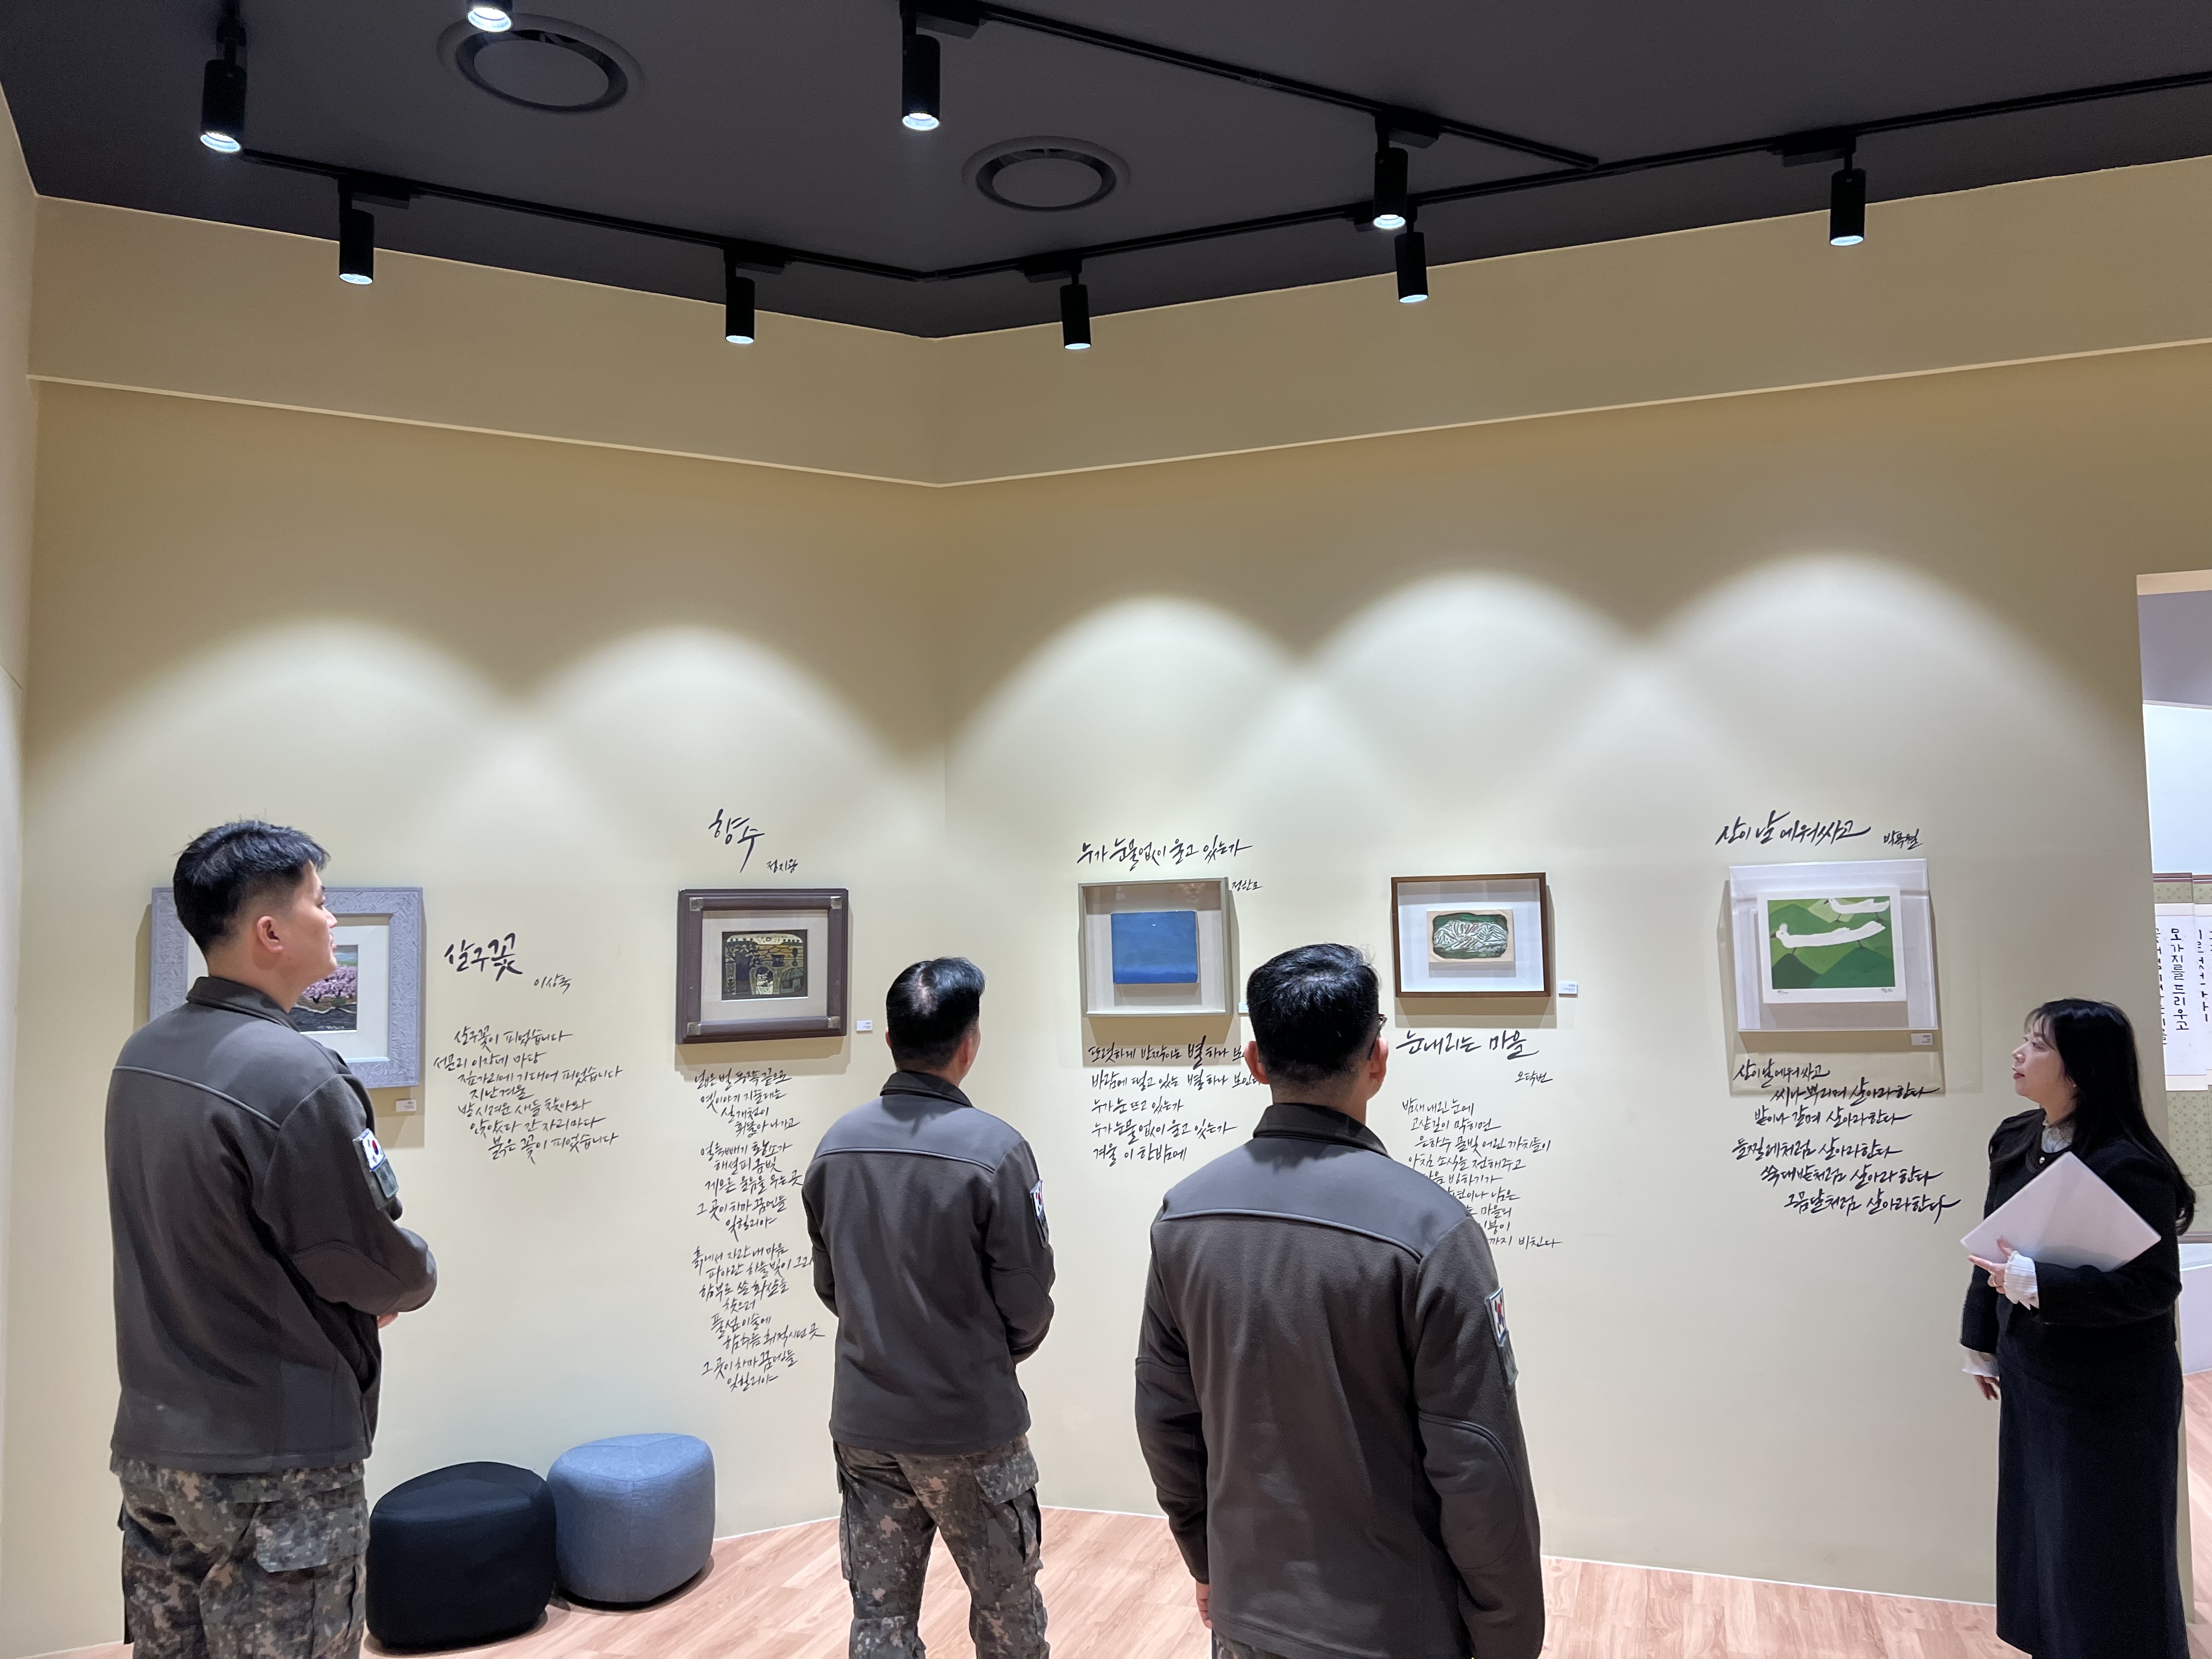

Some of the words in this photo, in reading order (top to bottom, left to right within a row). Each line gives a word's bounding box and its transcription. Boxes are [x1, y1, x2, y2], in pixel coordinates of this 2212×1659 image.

[708, 808, 766, 873] 향수
[1076, 842, 1109, 864] 누가
[1169, 838, 1200, 865] 울고
[1203, 834, 1254, 864] 있는가
[1883, 828, 1923, 850] 박목월
[1232, 878, 1263, 892] 정한모
[444, 932, 523, 982] 살구꽃
[2170, 928, 2186, 980] 모가지를
[2172, 984, 2190, 1030] 드리우고
[454, 1025, 499, 1053] 살구꽃이
[503, 1029, 573, 1047] 피었습니다
[1489, 1030, 1540, 1060] 마을
[513, 1052, 547, 1069] 마당
[1088, 1041, 1136, 1063] 또렷하게
[1141, 1044, 1182, 1063] 반짝이는
[1188, 1035, 1206, 1070] 별
[1205, 1046, 1229, 1059] 하나
[1232, 1045, 1245, 1062] 보
[517, 1070, 559, 1083] 기대어
[561, 1065, 623, 1087] 피었습니다
[719, 1067, 733, 1091] 벌
[733, 1070, 760, 1087] 동쪽
[760, 1067, 793, 1087] 끝으로
[1092, 1069, 1128, 1090] 바람에
[1131, 1070, 1157, 1092] 떨고
[1158, 1073, 1180, 1090] 있는
[1187, 1069, 1205, 1091] 별
[1206, 1074, 1229, 1086] 하나
[1514, 1070, 1554, 1087] 오탁번
[515, 1099, 541, 1118] 새들
[544, 1097, 592, 1113] 찾아와
[720, 1104, 770, 1125] 실개천이
[1091, 1099, 1114, 1114] 누가
[1112, 1097, 1127, 1115] 눈
[1130, 1099, 1148, 1111] 뜨고
[1152, 1096, 1184, 1114] 있는가
[1402, 1097, 1425, 1115] 밤새
[1427, 1101, 1450, 1114] 내린
[1451, 1098, 1474, 1116] 눈에
[524, 1119, 542, 1132] 간
[542, 1116, 607, 1132] 자리마다
[1091, 1122, 1113, 1137] 누가
[1166, 1119, 1192, 1138] 울고
[1194, 1118, 1238, 1140] 있는가
[1454, 1116, 1502, 1135] 막히면
[488, 1135, 516, 1160] 붉은
[520, 1134, 548, 1165] 꽃이
[550, 1132, 619, 1153] 피었습니다
[751, 1139, 793, 1159] 황소가
[1093, 1143, 1118, 1167] 겨울
[1124, 1148, 1134, 1160] 이
[1414, 1135, 1452, 1154] 은하수
[1454, 1135, 1482, 1158] 물빛
[1482, 1137, 1506, 1150] 어린
[1508, 1136, 1551, 1153] 까치들이
[1731, 1136, 1817, 1161] 들찔레처럼
[751, 1154, 782, 1175] 금빛
[1408, 1153, 1435, 1169] 아침
[1437, 1154, 1470, 1172] 소식을
[740, 1175, 768, 1195] 울음을
[770, 1174, 788, 1189] 우는
[788, 1169, 803, 1187] 곳
[1448, 1172, 1504, 1187] 빙하기가
[1760, 1164, 1847, 1188] 쑥대밭처럼
[1491, 1186, 1521, 1204] 남은
[1784, 1188, 1862, 1217] 그믐달처럼
[1481, 1203, 1512, 1219] 마을의
[727, 1245, 752, 1260] 자란
[752, 1246, 764, 1257] 내
[765, 1242, 789, 1261] 마음
[1518, 1235, 1563, 1250] 비친다
[705, 1263, 744, 1284] 파아란
[793, 1256, 812, 1268] 그리
[698, 1282, 734, 1304] 함부로
[751, 1278, 789, 1301] 화살을
[722, 1297, 756, 1314] 찾으러
[742, 1313, 771, 1331] 이슬에
[809, 1322, 826, 1340] 곳
